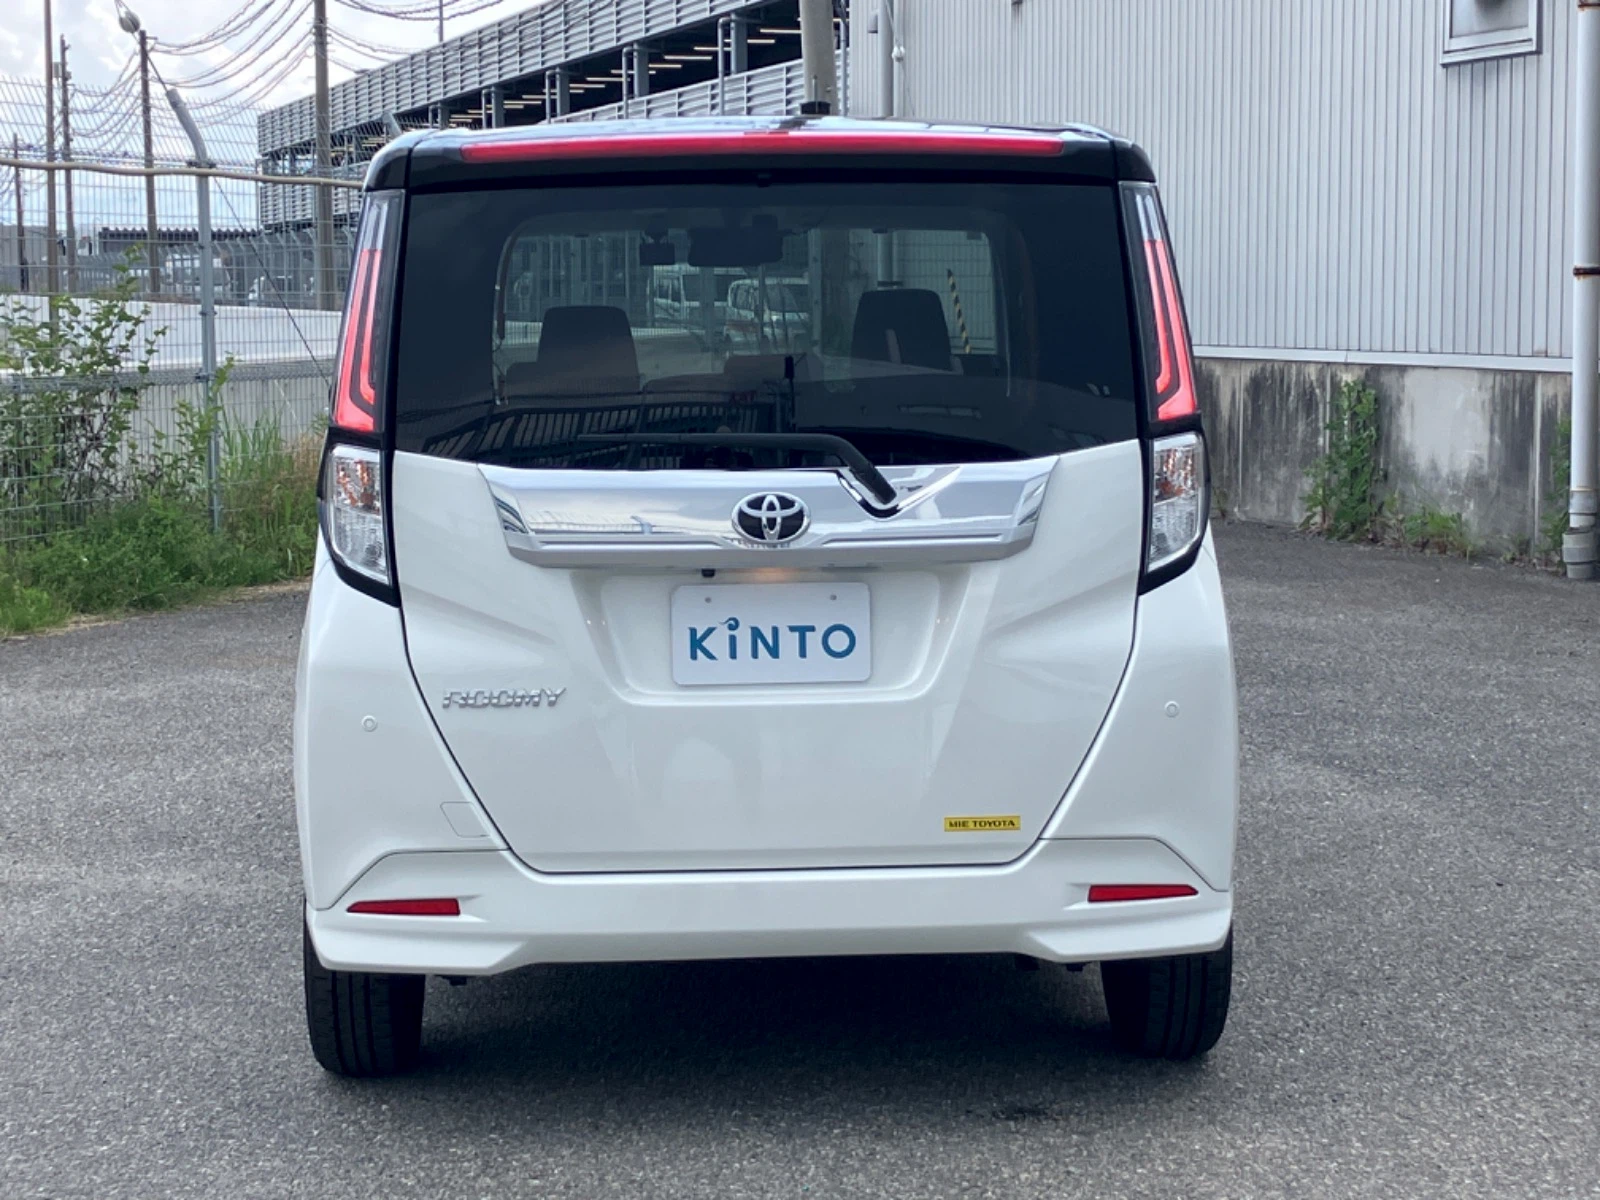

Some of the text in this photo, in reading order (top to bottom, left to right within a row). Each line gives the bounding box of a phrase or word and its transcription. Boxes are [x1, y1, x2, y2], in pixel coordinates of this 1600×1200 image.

[442, 687, 567, 708] ROOMY
[948, 819, 1015, 828] MIE TOYOTA
